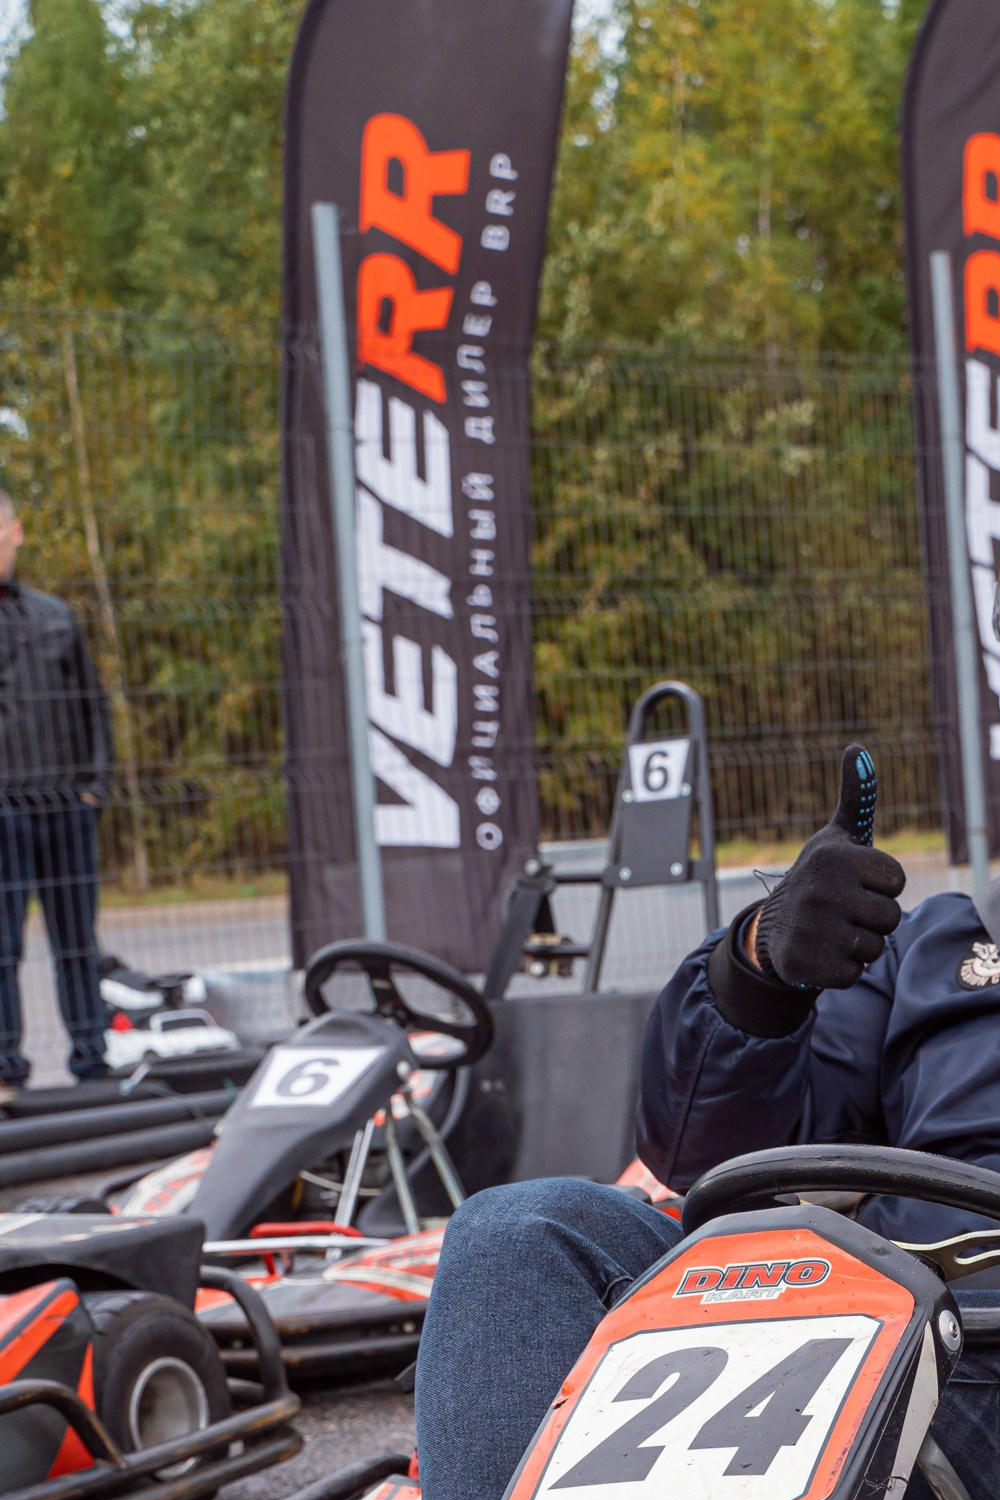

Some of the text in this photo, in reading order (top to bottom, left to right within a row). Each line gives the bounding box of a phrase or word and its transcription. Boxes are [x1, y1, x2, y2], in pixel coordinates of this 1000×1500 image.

[355, 111, 471, 850] VETERR
[456, 152, 519, 851] ОФИЦИАЛЬНЫЙ ДИЛЕР BRP
[643, 750, 670, 794] 6
[274, 1057, 342, 1098] 6
[676, 1259, 830, 1296] DINO
[704, 1286, 783, 1303] KART
[547, 1337, 855, 1490] 24
